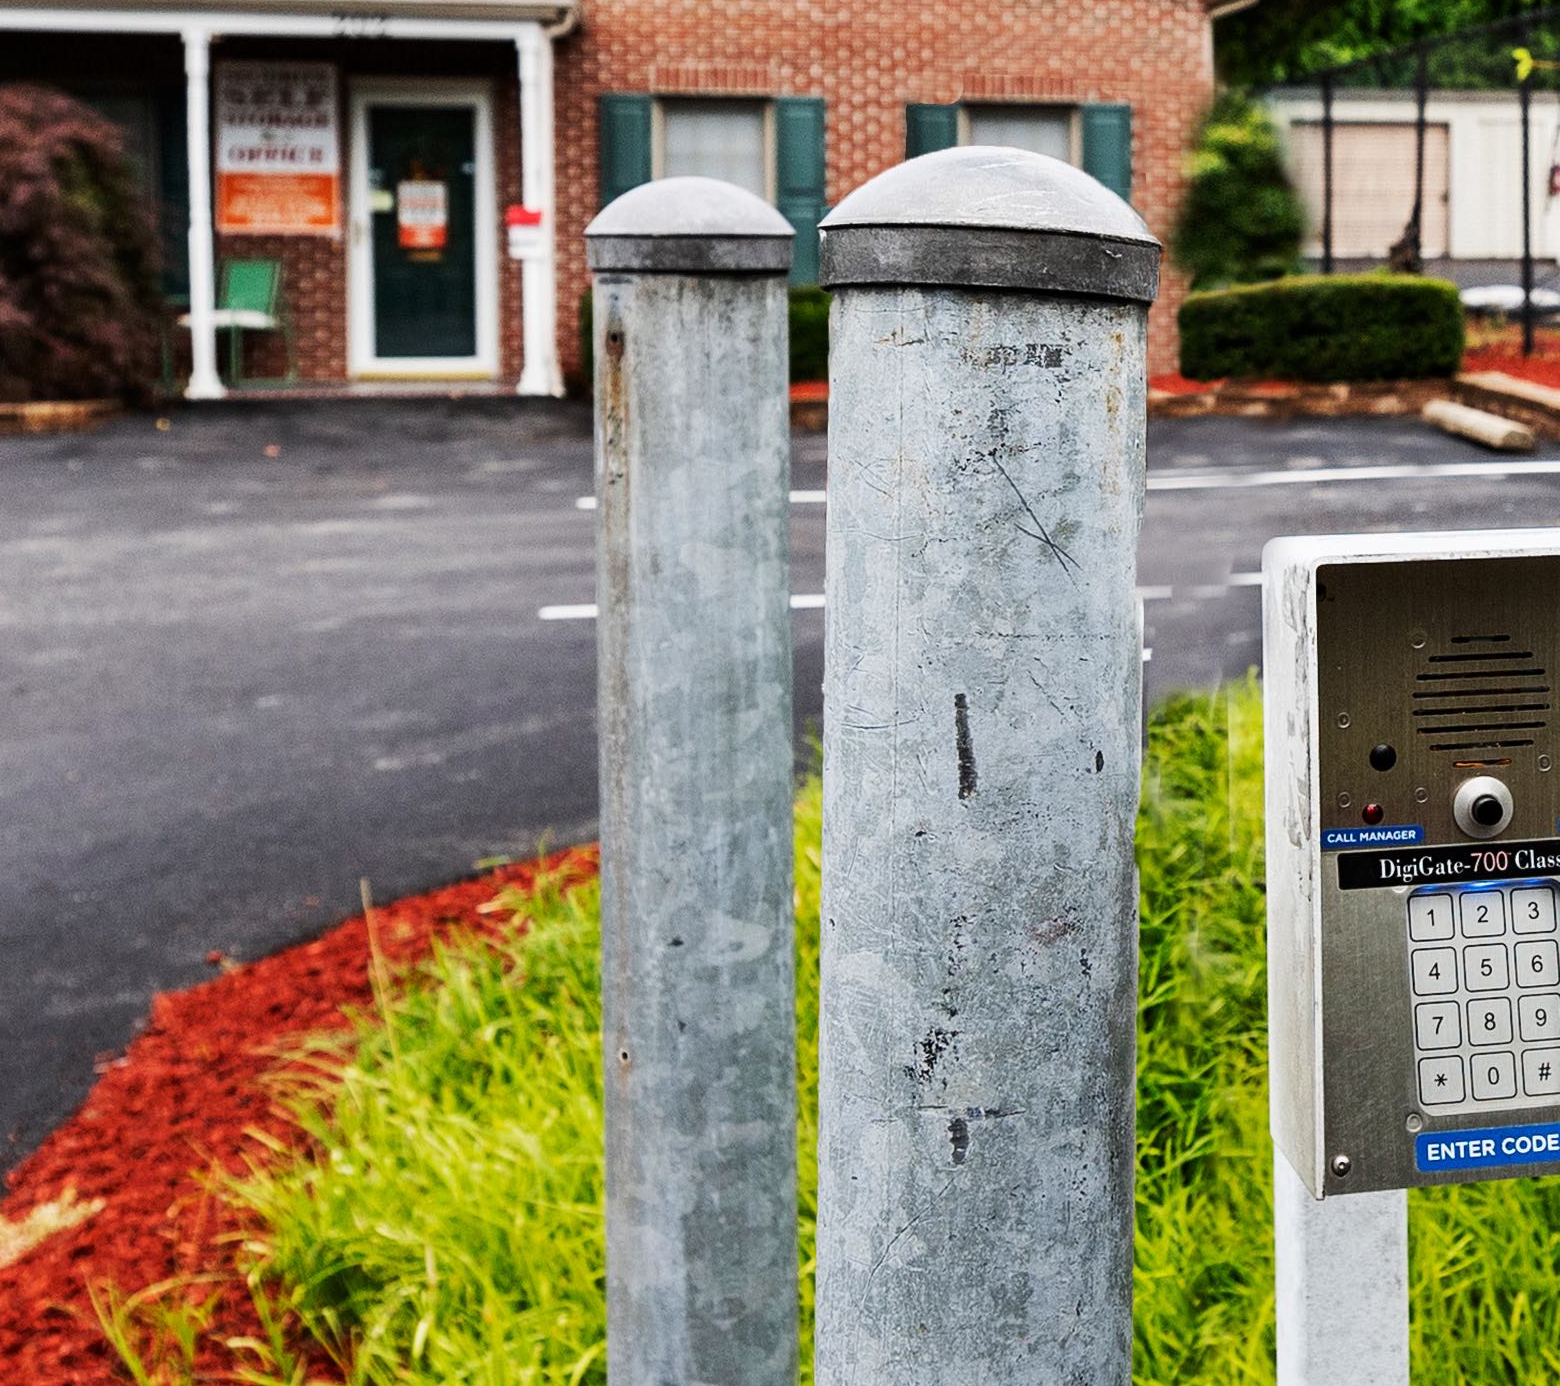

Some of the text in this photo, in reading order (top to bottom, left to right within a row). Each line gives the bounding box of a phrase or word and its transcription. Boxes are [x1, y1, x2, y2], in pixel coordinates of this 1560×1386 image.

[1326, 828, 1417, 843] CALL MANAGER
[1426, 901, 1540, 926] 1 2 3
[1428, 954, 1543, 980] 4 5 6
[1432, 1008, 1547, 1035] 7 8 9
[1487, 1066, 1500, 1085] 0
[1427, 1139, 1496, 1161] ENTER
[1501, 1133, 1560, 1155] CODE
